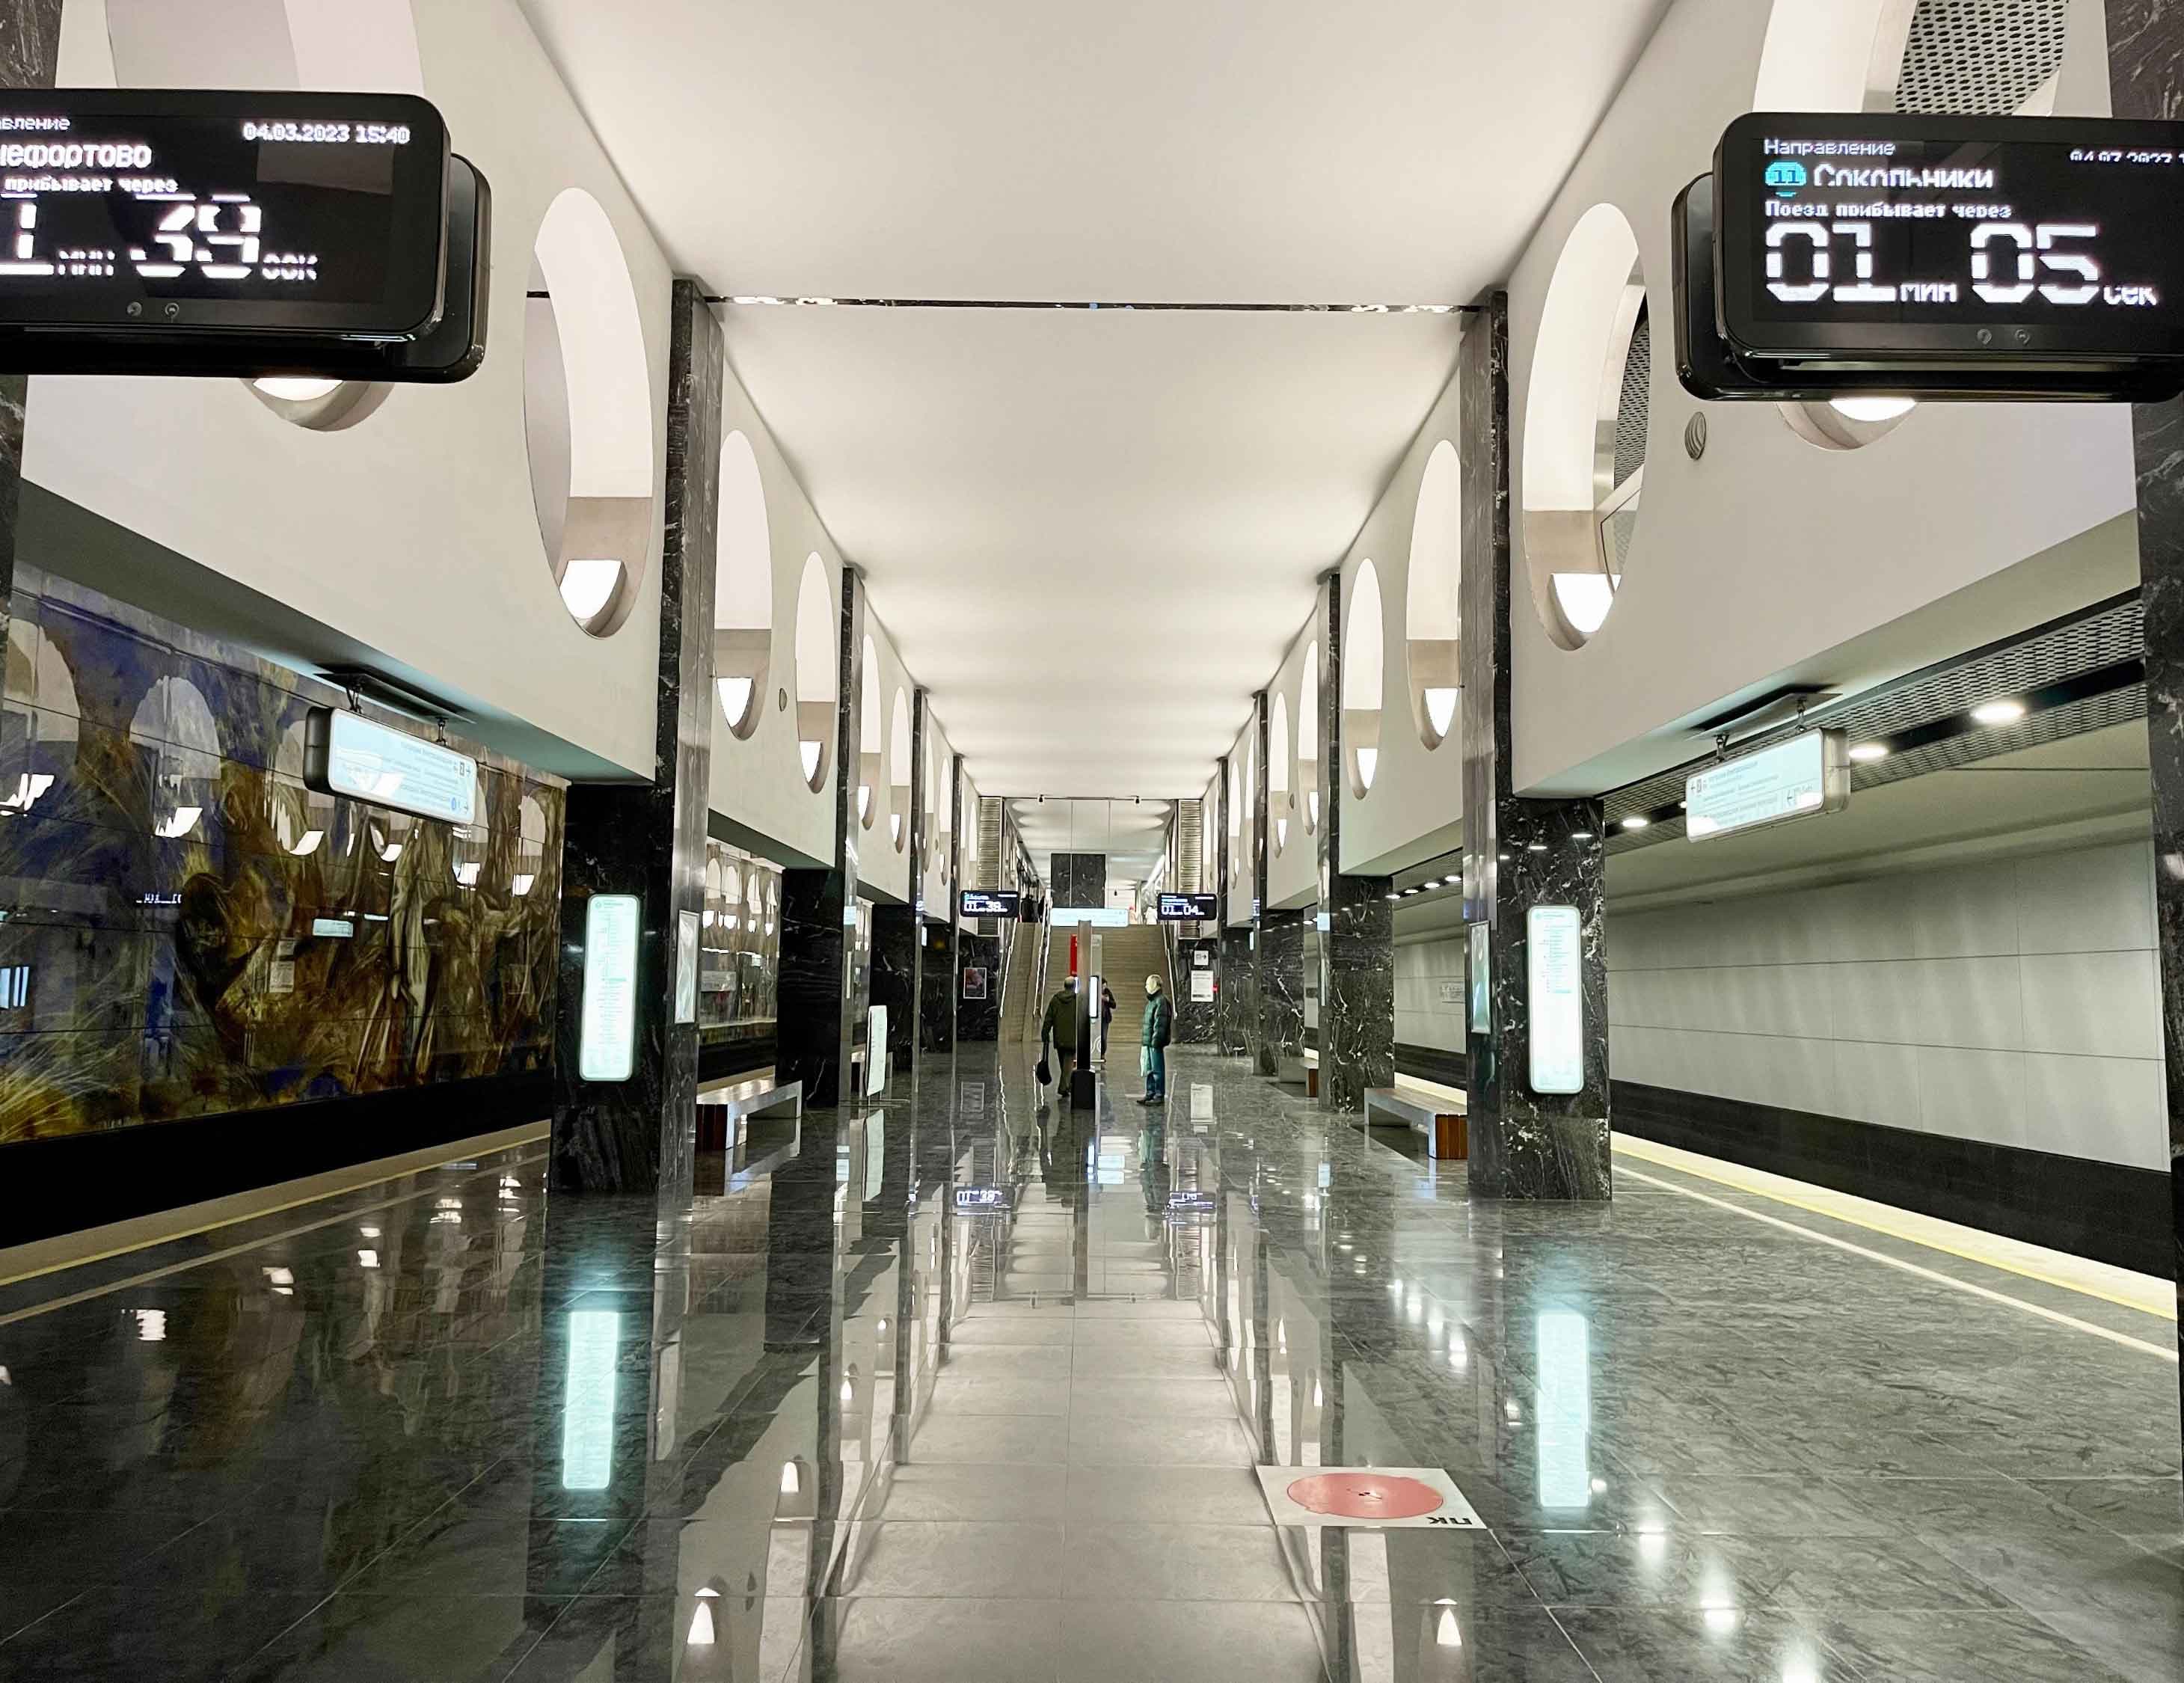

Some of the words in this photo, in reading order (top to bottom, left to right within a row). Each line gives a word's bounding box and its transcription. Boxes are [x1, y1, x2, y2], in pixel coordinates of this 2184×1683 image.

[0, 117, 70, 130] вление
[243, 122, 350, 142] 04.03.2023
[355, 124, 411, 144] 15:40
[1763, 138, 1896, 156] Направление
[4, 176, 112, 192] прибывает
[118, 177, 179, 193] через
[1813, 163, 1993, 188] Сокольники
[1764, 199, 1829, 218] Поезд
[1835, 202, 1946, 218] прибывает
[1951, 204, 2012, 219] через
[130, 192, 261, 279] 39
[1765, 222, 1898, 303] 01
[1900, 282, 1958, 303] мин
[1970, 223, 2100, 305] 05
